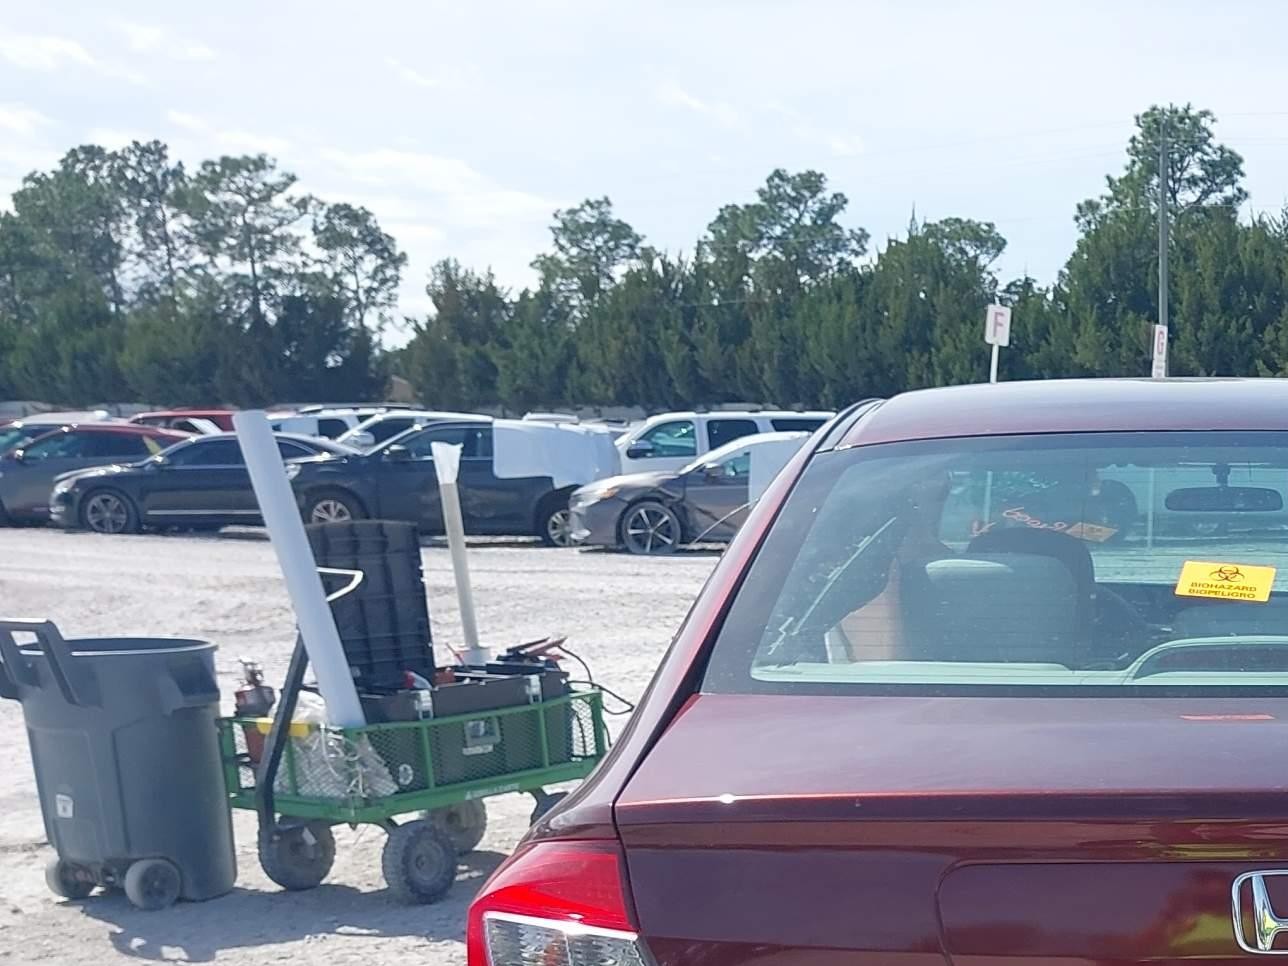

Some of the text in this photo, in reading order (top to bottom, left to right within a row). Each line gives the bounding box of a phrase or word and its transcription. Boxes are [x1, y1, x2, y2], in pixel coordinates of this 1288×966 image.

[993, 311, 1005, 338] F
[1157, 330, 1165, 355] G
[1188, 588, 1256, 599] BIOPELIGRO
[1190, 581, 1257, 592] BIOHAZARD
